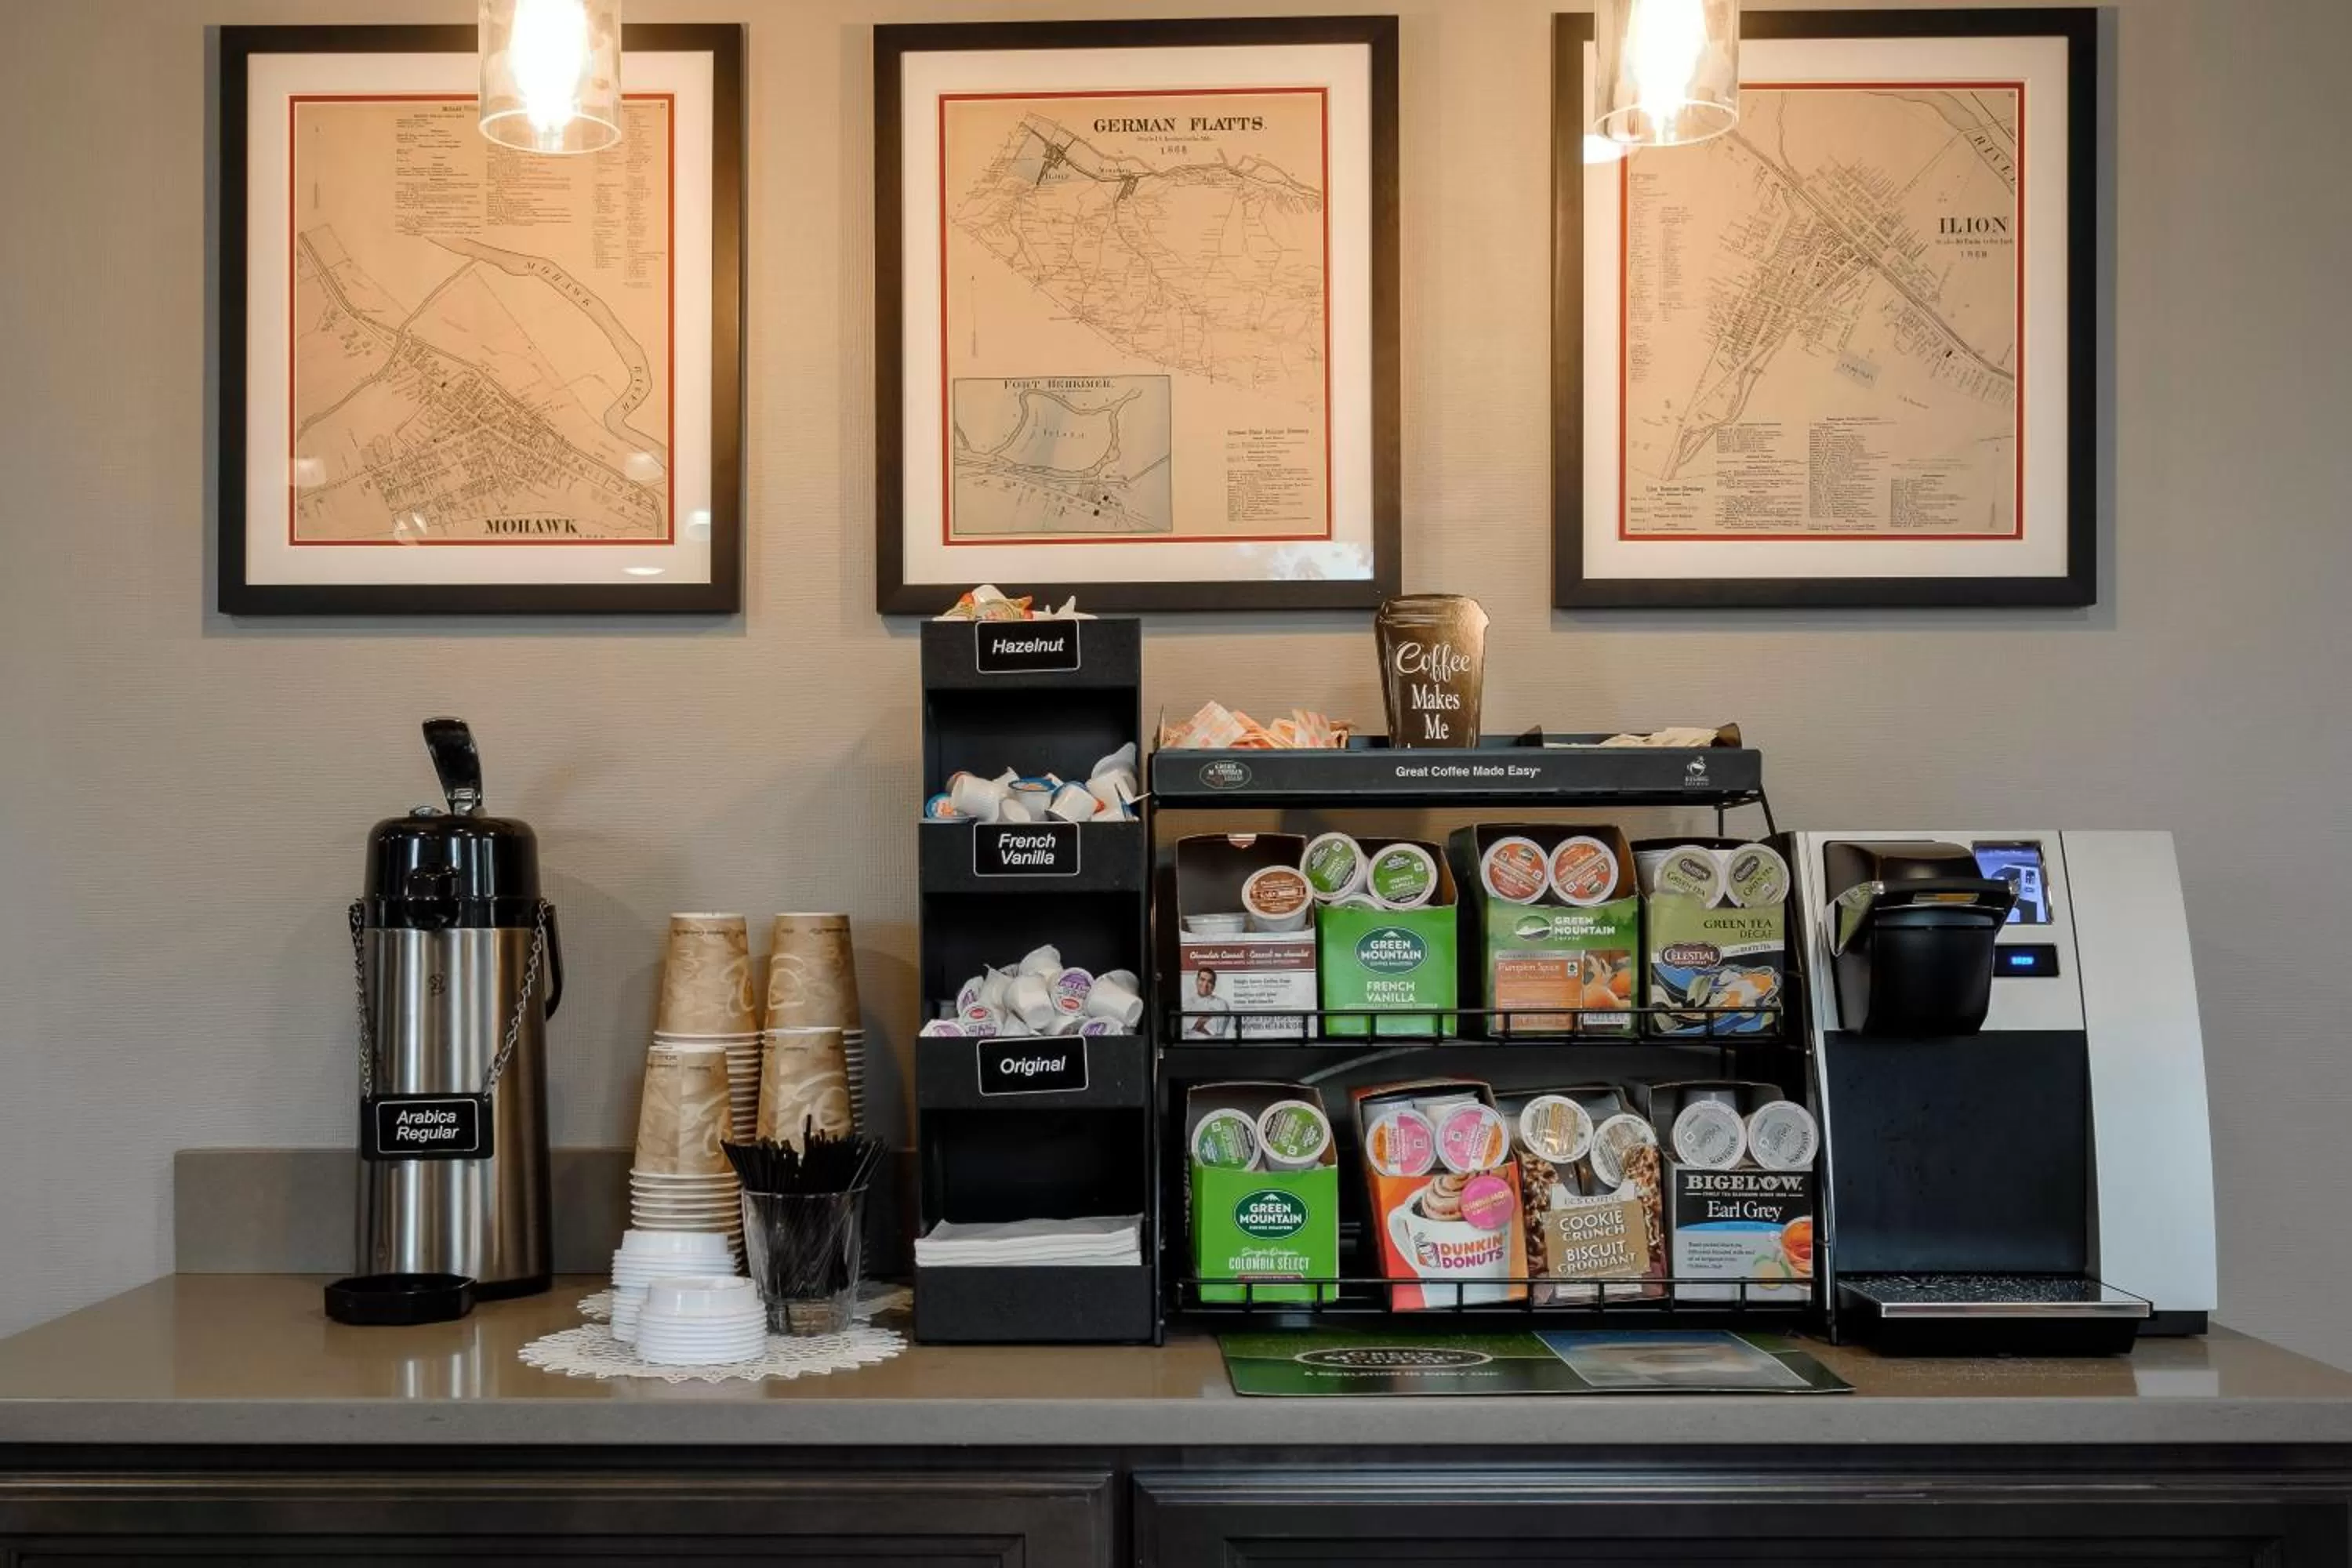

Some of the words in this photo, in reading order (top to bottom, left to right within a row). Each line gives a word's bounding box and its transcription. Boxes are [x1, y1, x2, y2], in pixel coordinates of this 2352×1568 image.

[1094, 118, 1176, 132] GERMAN
[1940, 216, 2008, 234] ILION
[485, 518, 578, 534] MOHAWK
[992, 637, 1065, 655] Hazelnut
[1396, 641, 1471, 683] Coffee
[1411, 684, 1461, 710] Makes
[1424, 713, 1450, 739] Me
[1396, 766, 1428, 777] Great
[1431, 766, 1470, 777] Coffee
[1473, 766, 1504, 776] Made
[998, 833, 1056, 849] French
[1001, 849, 1054, 865] Vanilla
[1555, 916, 1594, 925] GREEN
[1704, 918, 1746, 929] GREEN
[1750, 918, 1772, 928] TEA
[1555, 926, 1616, 935] MOUNTAIN
[1740, 930, 1775, 938] DECAF
[1370, 940, 1411, 949] GREEN
[1360, 949, 1422, 960] MOUNTAIN
[1367, 981, 1416, 991] FRENCH
[1367, 992, 1416, 1003] VANILLA
[1000, 1055, 1066, 1076] Original
[396, 1109, 457, 1125] Arabica
[396, 1125, 459, 1144] Regular
[1249, 1203, 1291, 1213] GREEN
[1707, 1201, 1740, 1218] Earl
[1743, 1201, 1783, 1221] Grey
[1240, 1214, 1302, 1224] MOUNTAIN
[1559, 1210, 1624, 1232] COOKIE
[1563, 1225, 1625, 1241] CRUNCH
[1442, 1247, 1504, 1269] DONUTS
[1566, 1240, 1625, 1261] BISCUIT
[1229, 1257, 1275, 1270] COLOMBIA
[1277, 1257, 1310, 1270] SELECT
[1557, 1253, 1637, 1274] CROQUANT
